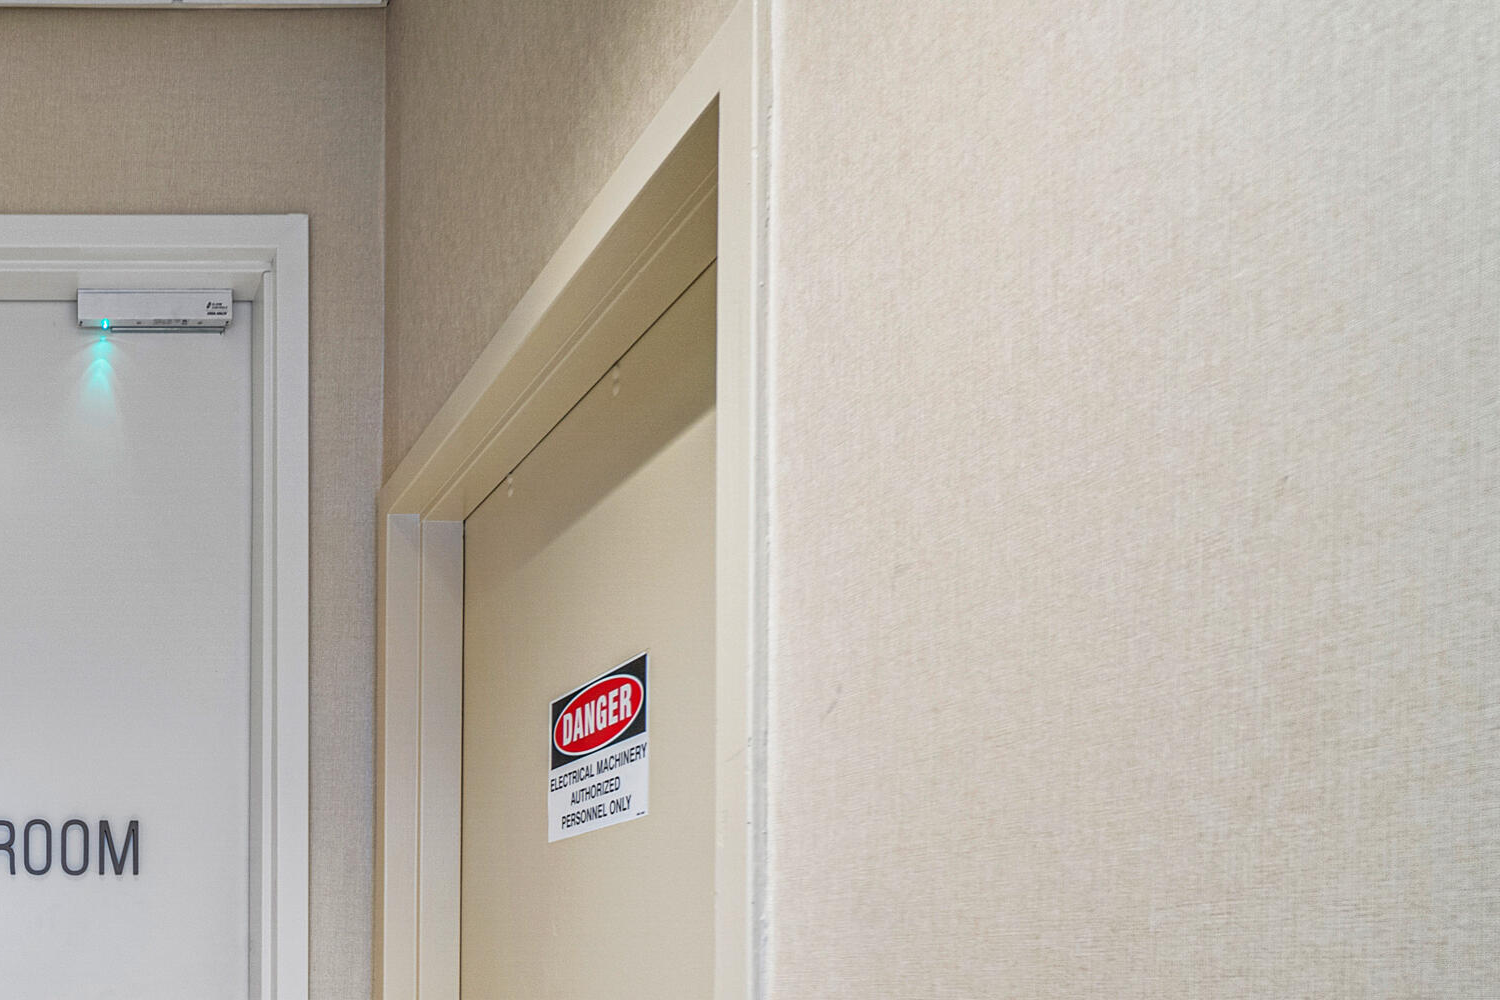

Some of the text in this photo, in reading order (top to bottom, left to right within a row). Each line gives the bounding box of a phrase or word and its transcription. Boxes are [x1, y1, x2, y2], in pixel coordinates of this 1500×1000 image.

[562, 683, 632, 746] DANGER
[550, 742, 648, 793] ELECTRICAL MACHINERY
[561, 795, 632, 830] PERSONNEL ONLY
[570, 776, 621, 807] AUTHORIZED
